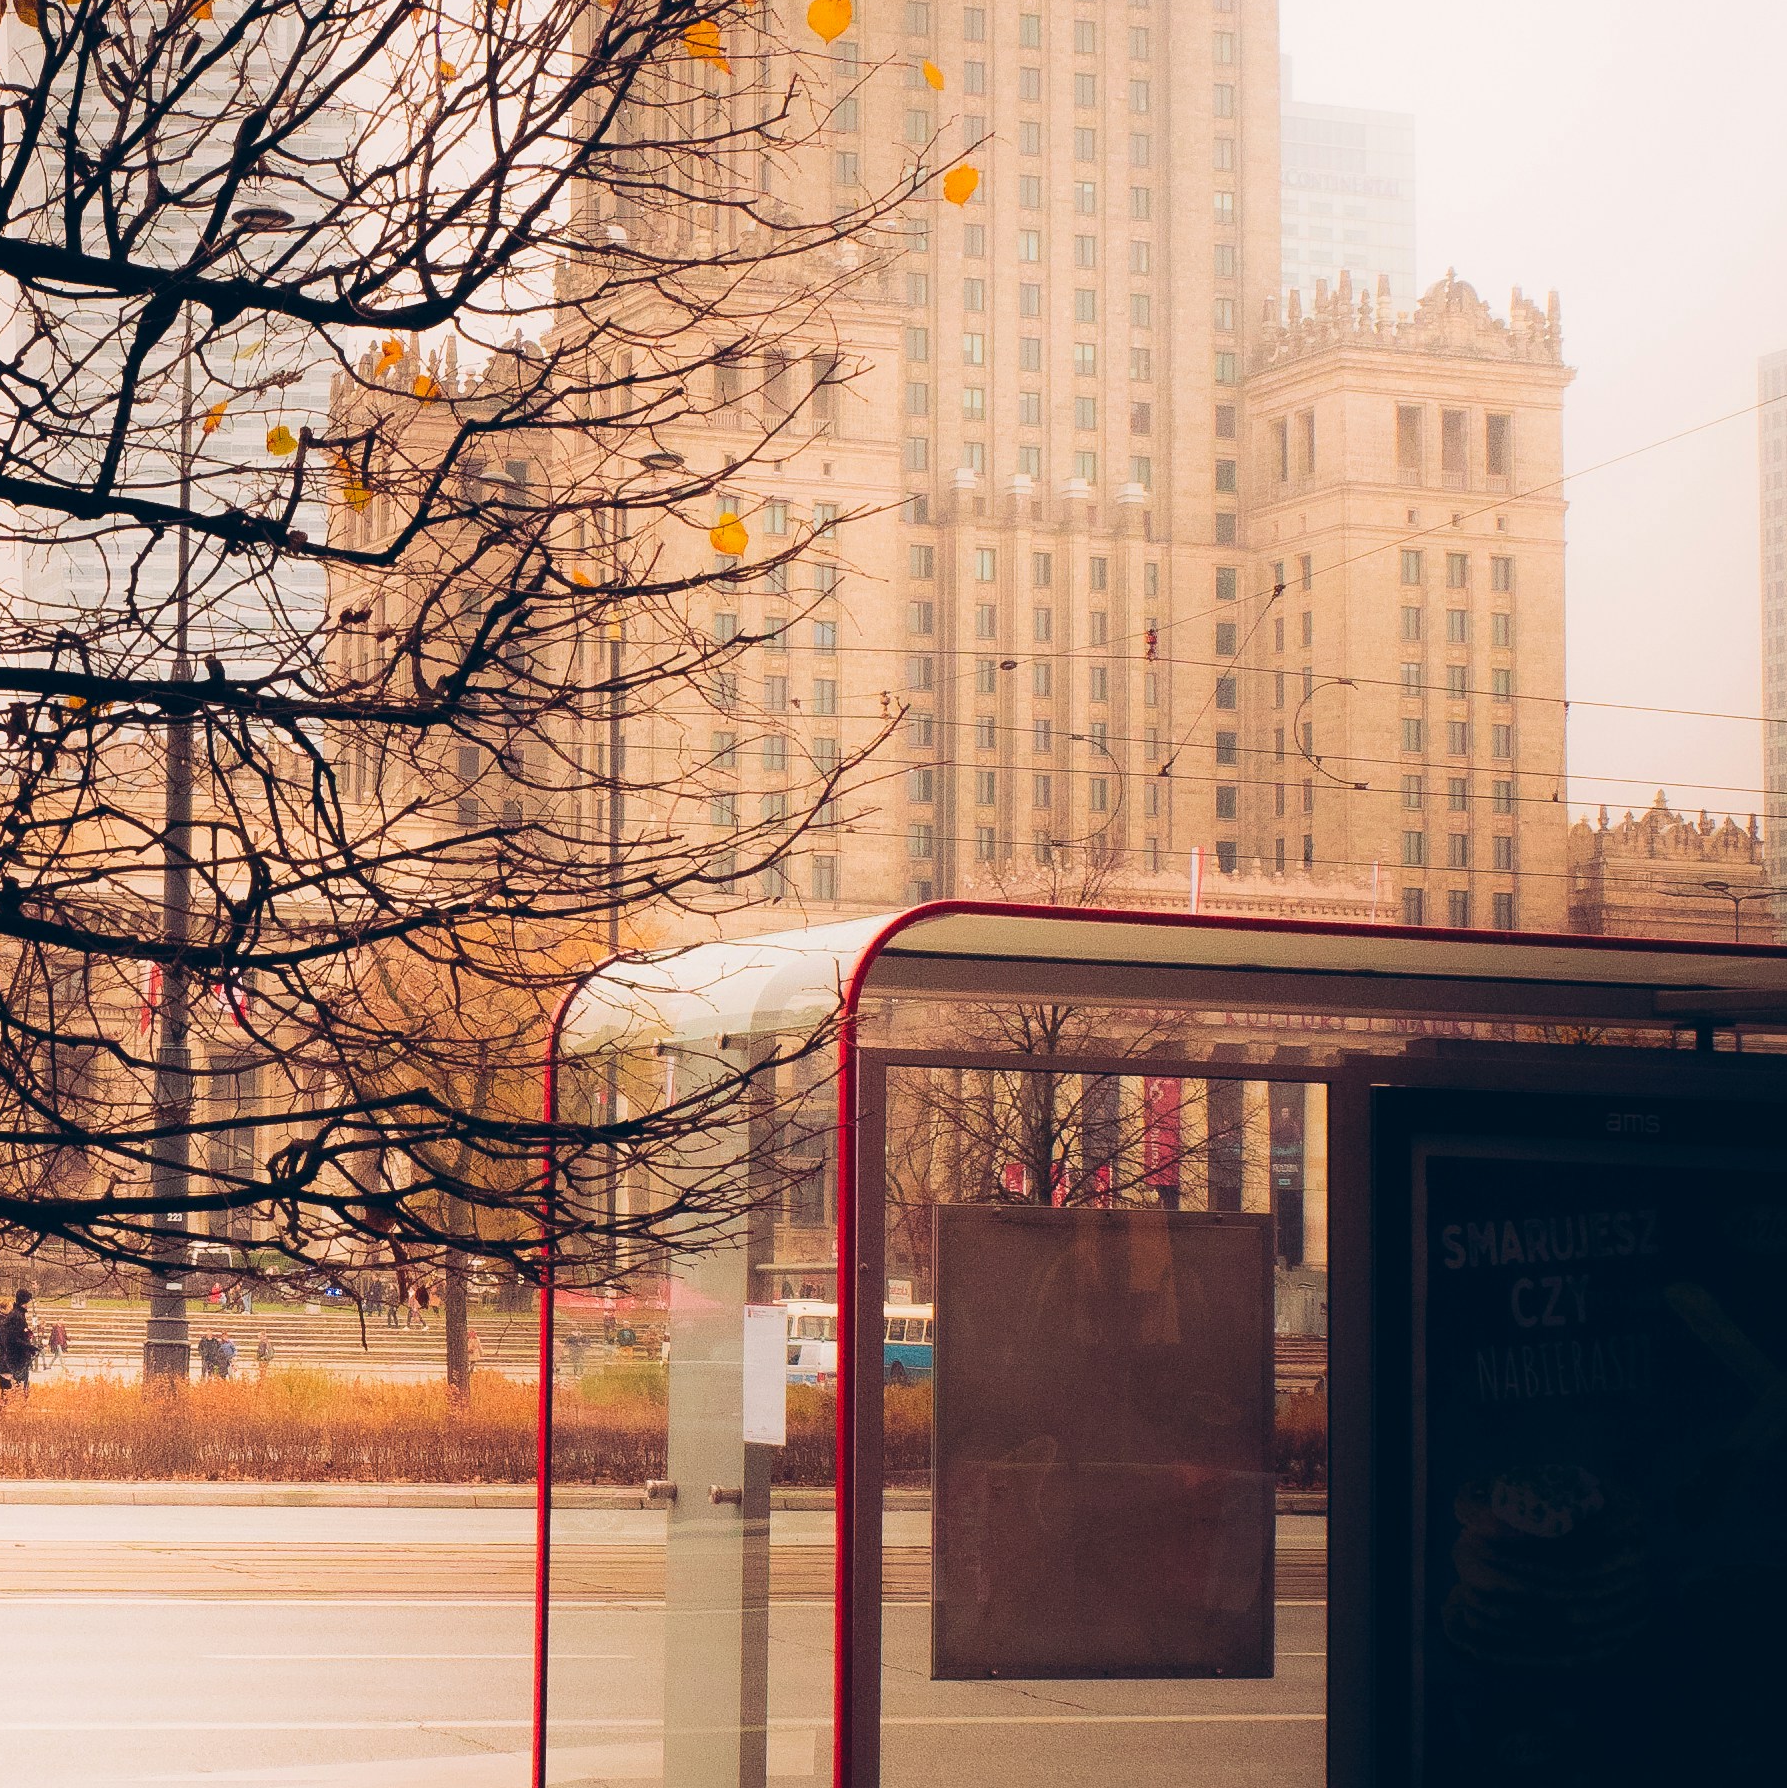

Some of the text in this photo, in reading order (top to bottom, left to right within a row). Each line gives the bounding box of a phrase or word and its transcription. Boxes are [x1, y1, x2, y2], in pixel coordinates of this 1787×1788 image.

[1605, 1112, 1661, 1133] ams
[1441, 1209, 1660, 1270] SMARUJESZ
[1511, 1274, 1591, 1329] CZY
